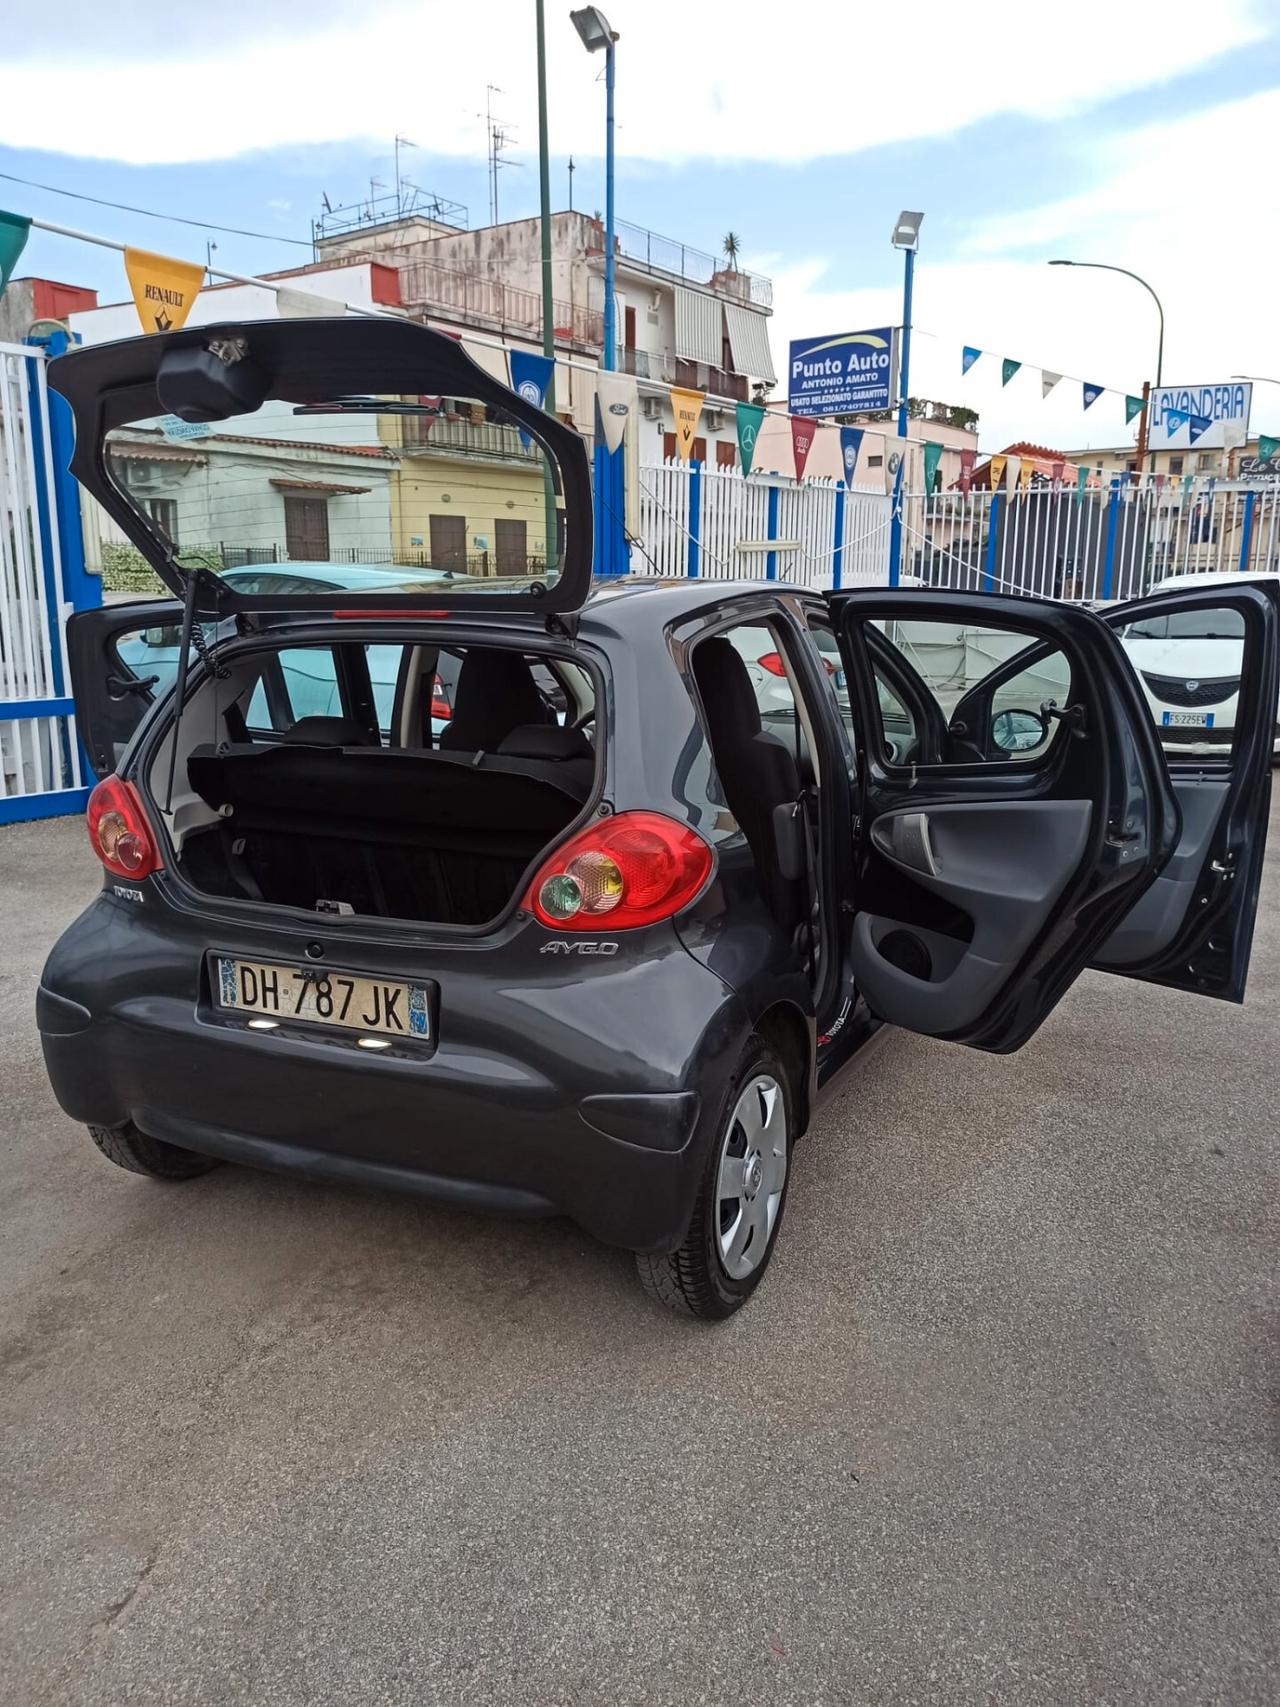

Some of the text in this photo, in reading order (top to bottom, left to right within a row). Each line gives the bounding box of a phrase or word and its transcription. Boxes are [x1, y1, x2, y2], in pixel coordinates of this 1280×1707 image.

[145, 284, 184, 307] RENAULT
[792, 352, 889, 379] Punto Auto
[802, 372, 878, 389] ANTONIO AMATO
[791, 388, 888, 406] USATO SELEZIONATO GARANTITO
[1153, 387, 1244, 426] LAVANDERIA
[539, 941, 619, 955] AYGO
[239, 966, 403, 1030] DH 787 JK
